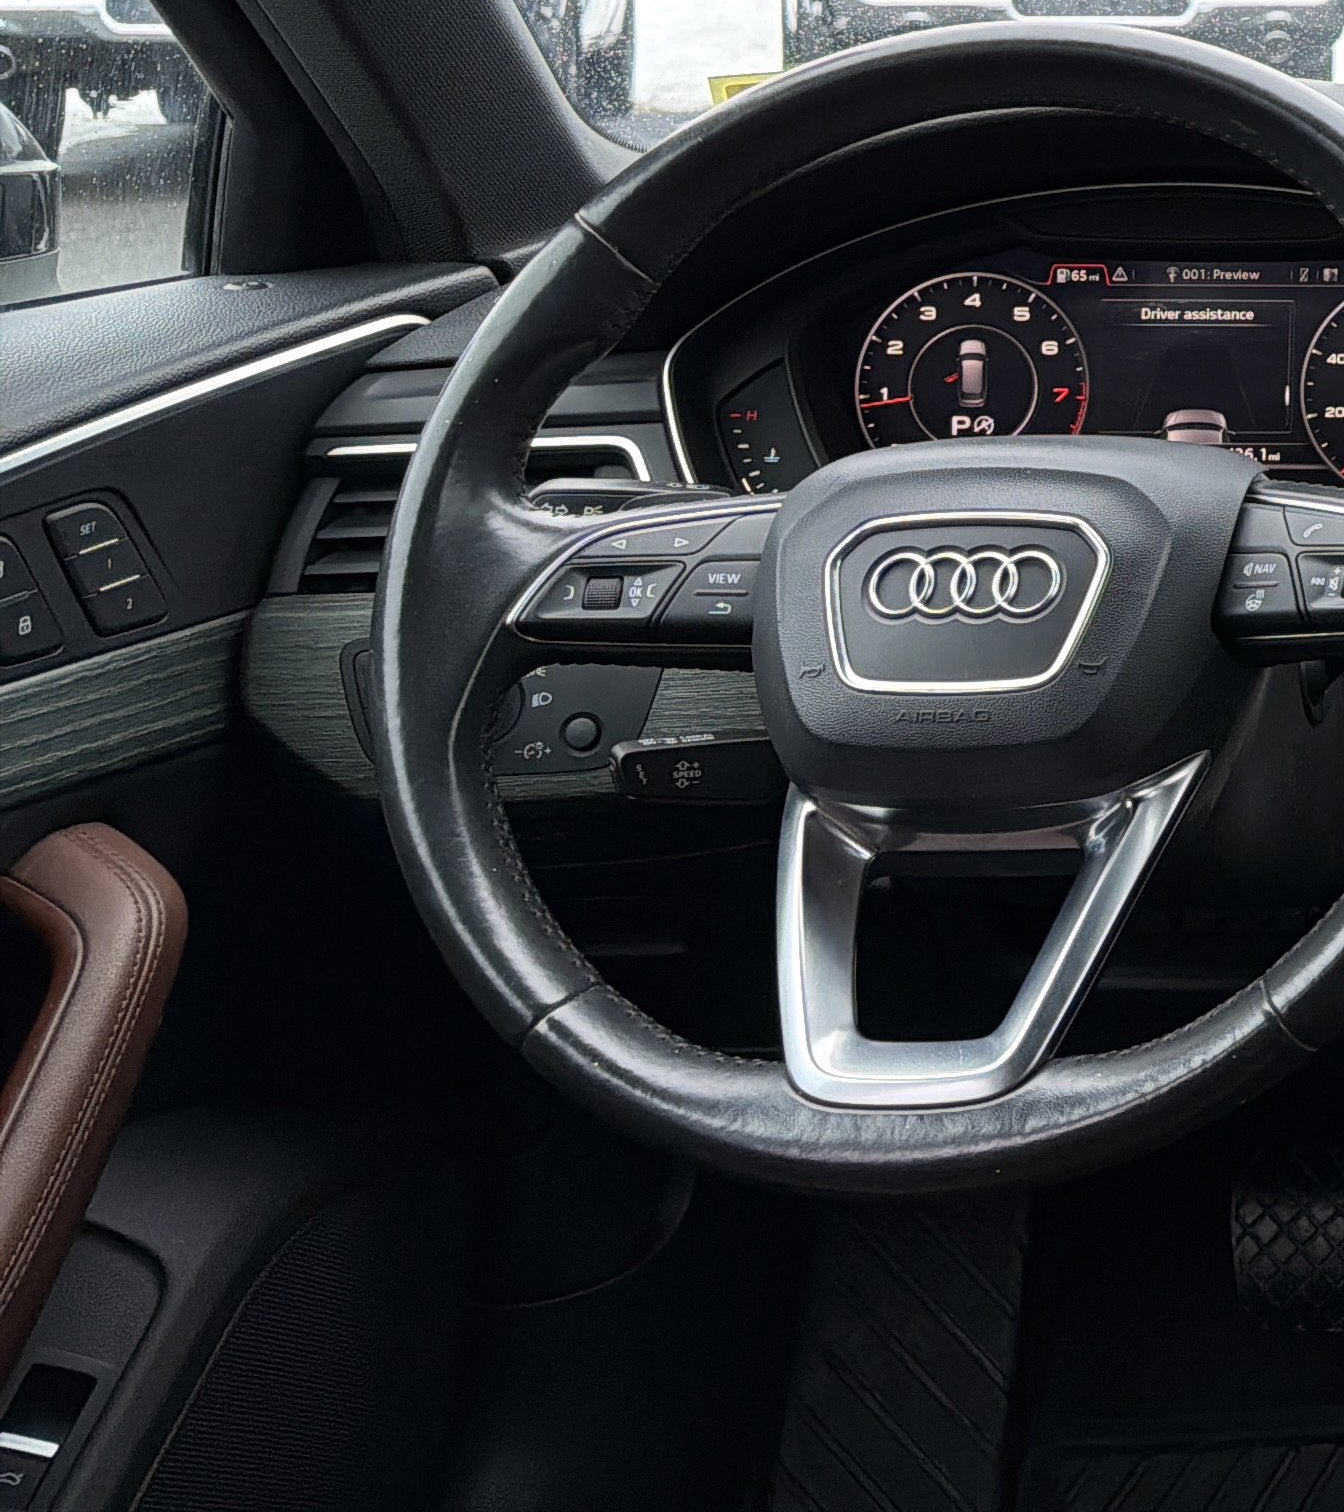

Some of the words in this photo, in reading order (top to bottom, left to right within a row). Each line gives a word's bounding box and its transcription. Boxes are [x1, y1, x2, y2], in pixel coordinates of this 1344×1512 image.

[1071, 269, 1087, 282] 65
[1089, 272, 1100, 282] mi
[1182, 269, 1211, 280] 001:
[1213, 269, 1260, 281] Preview
[963, 293, 982, 308] 4
[919, 306, 937, 321] 3
[1013, 306, 1031, 322] 5
[1140, 307, 1181, 321] Driver
[1183, 307, 1255, 321] assistance
[886, 340, 904, 355] 2
[1041, 340, 1059, 355] 6
[879, 387, 889, 401] 1
[1052, 387, 1070, 403] 7
[746, 409, 758, 421] H
[951, 416, 972, 436] P
[80, 521, 97, 536] SET
[1254, 563, 1277, 575] NAV
[707, 573, 741, 585] VIEW
[628, 585, 643, 599] OK
[126, 598, 133, 609] 2
[672, 769, 702, 779] SPEED
